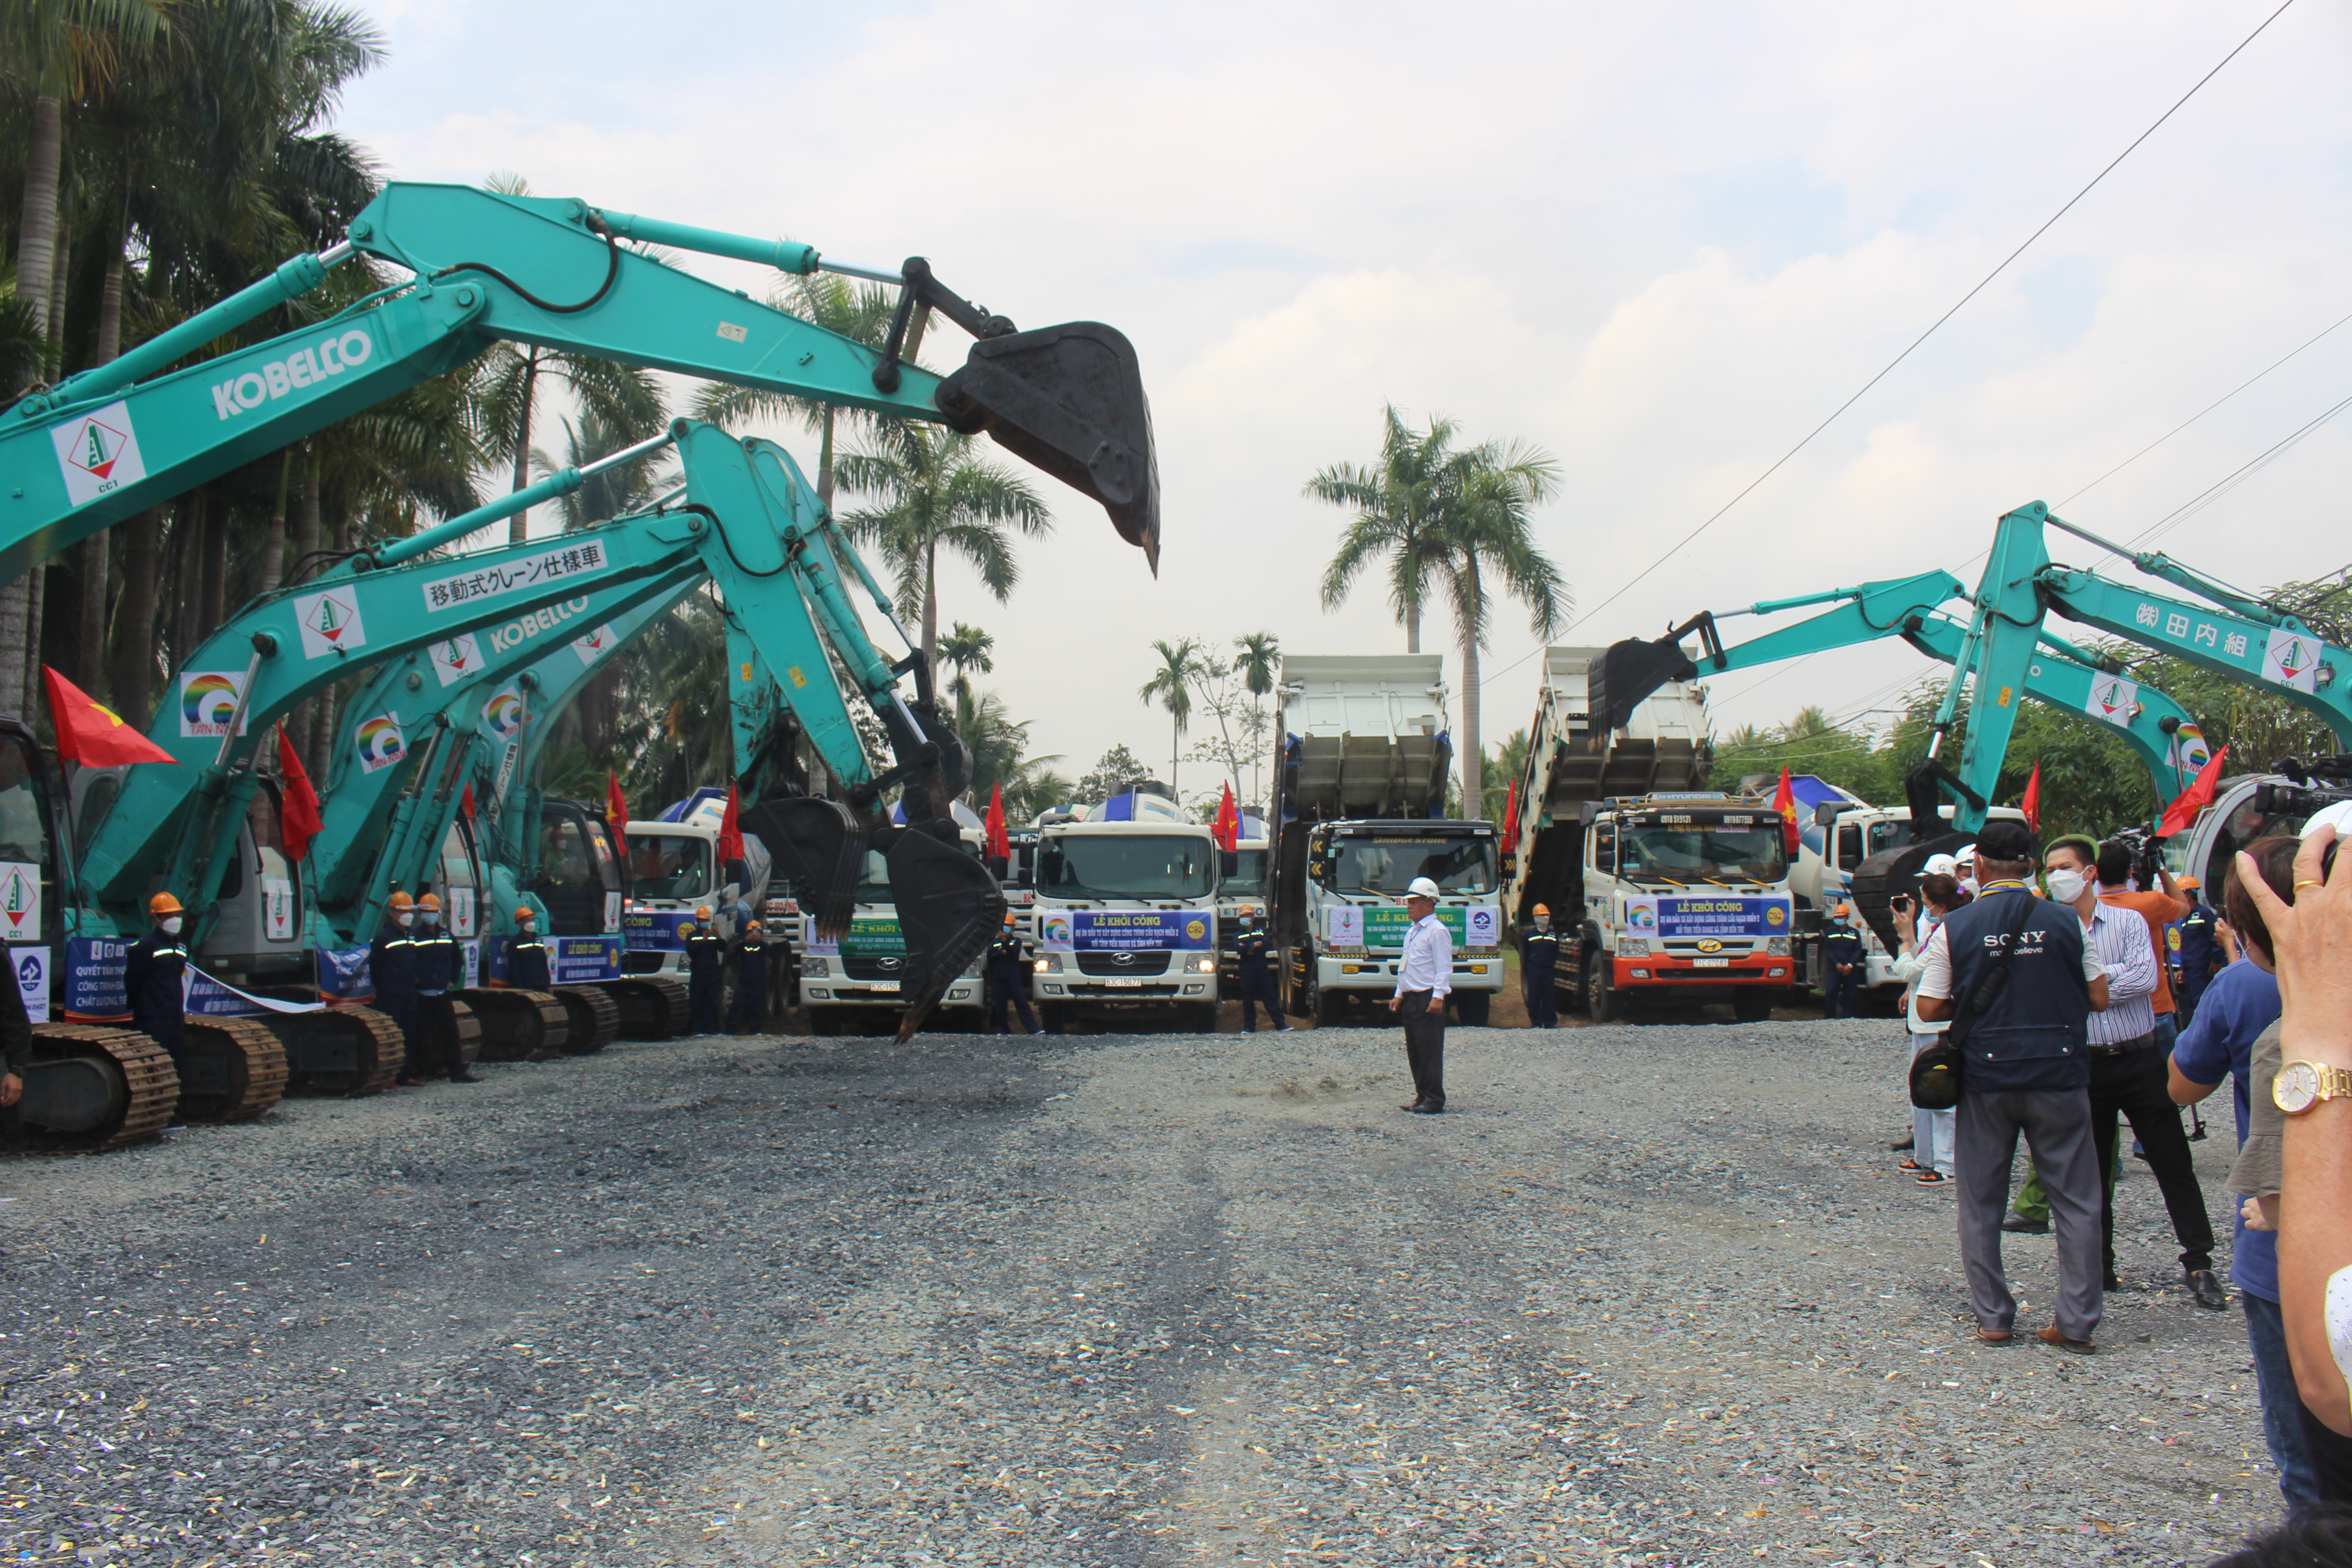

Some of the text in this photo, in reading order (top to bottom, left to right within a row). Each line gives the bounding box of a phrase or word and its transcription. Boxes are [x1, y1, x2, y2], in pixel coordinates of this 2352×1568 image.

[211, 330, 372, 421] KOBELCO
[98, 480, 118, 493] CC1
[430, 546, 602, 607] 移動式クレーン仕様車
[490, 595, 588, 654] KOBELCO
[2280, 679, 2294, 688] CC1
[1691, 900, 1714, 912] KHỞI
[1716, 901, 1743, 912] CÔNG
[1093, 913, 1161, 926] LỄ KHỞI CÔNG
[869, 923, 896, 933] KHỞI
[76, 965, 101, 976] QUYẾT
[78, 981, 98, 991] CÔNG
